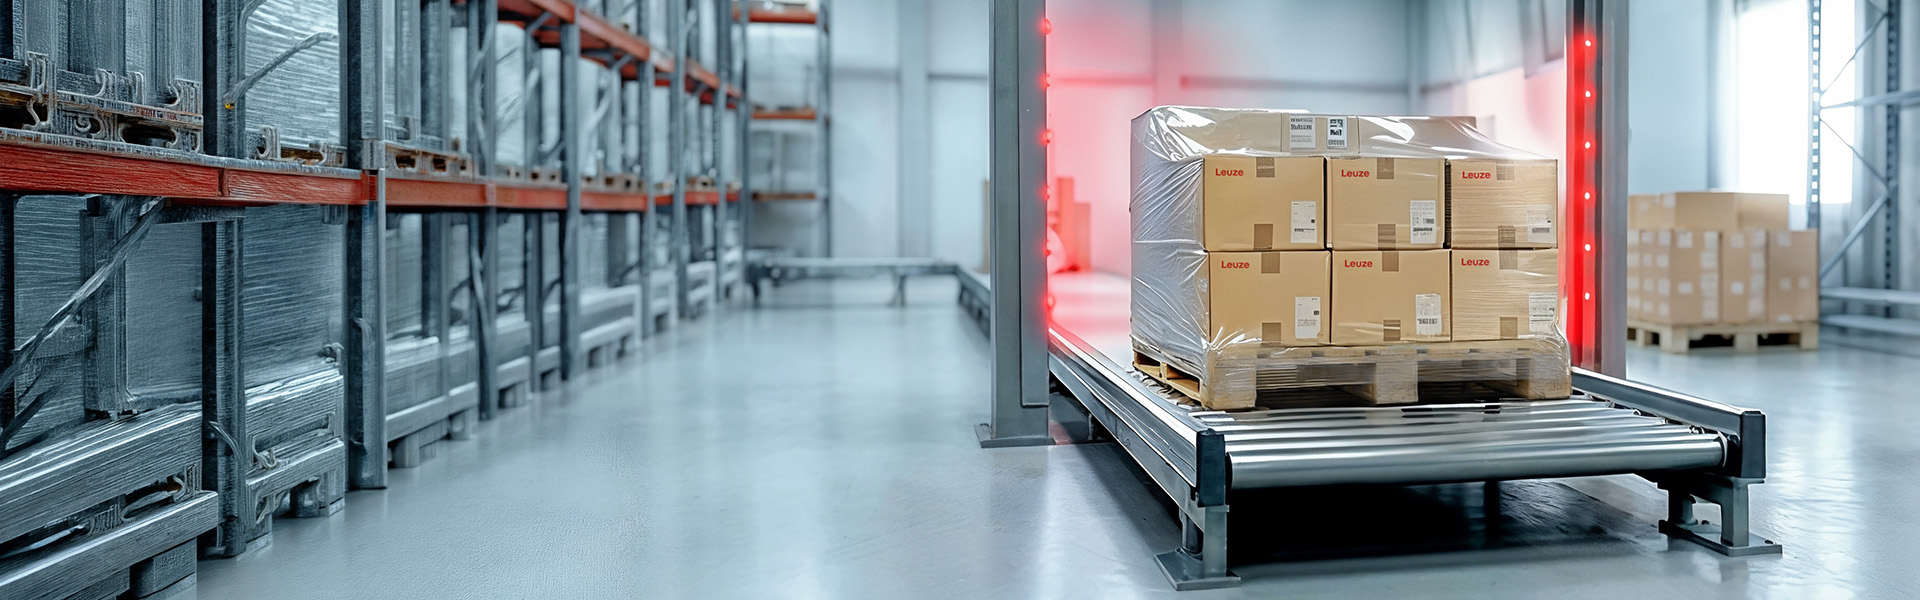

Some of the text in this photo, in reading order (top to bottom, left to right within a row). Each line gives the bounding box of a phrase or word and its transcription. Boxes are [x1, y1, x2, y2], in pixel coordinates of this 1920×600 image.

[1215, 168, 1244, 177] Leuze
[1341, 169, 1370, 178] Leuze
[1462, 170, 1491, 179] Leuze
[1221, 260, 1250, 269] Leuze
[1344, 260, 1373, 268] Leuze
[1461, 257, 1490, 266] Leuze
